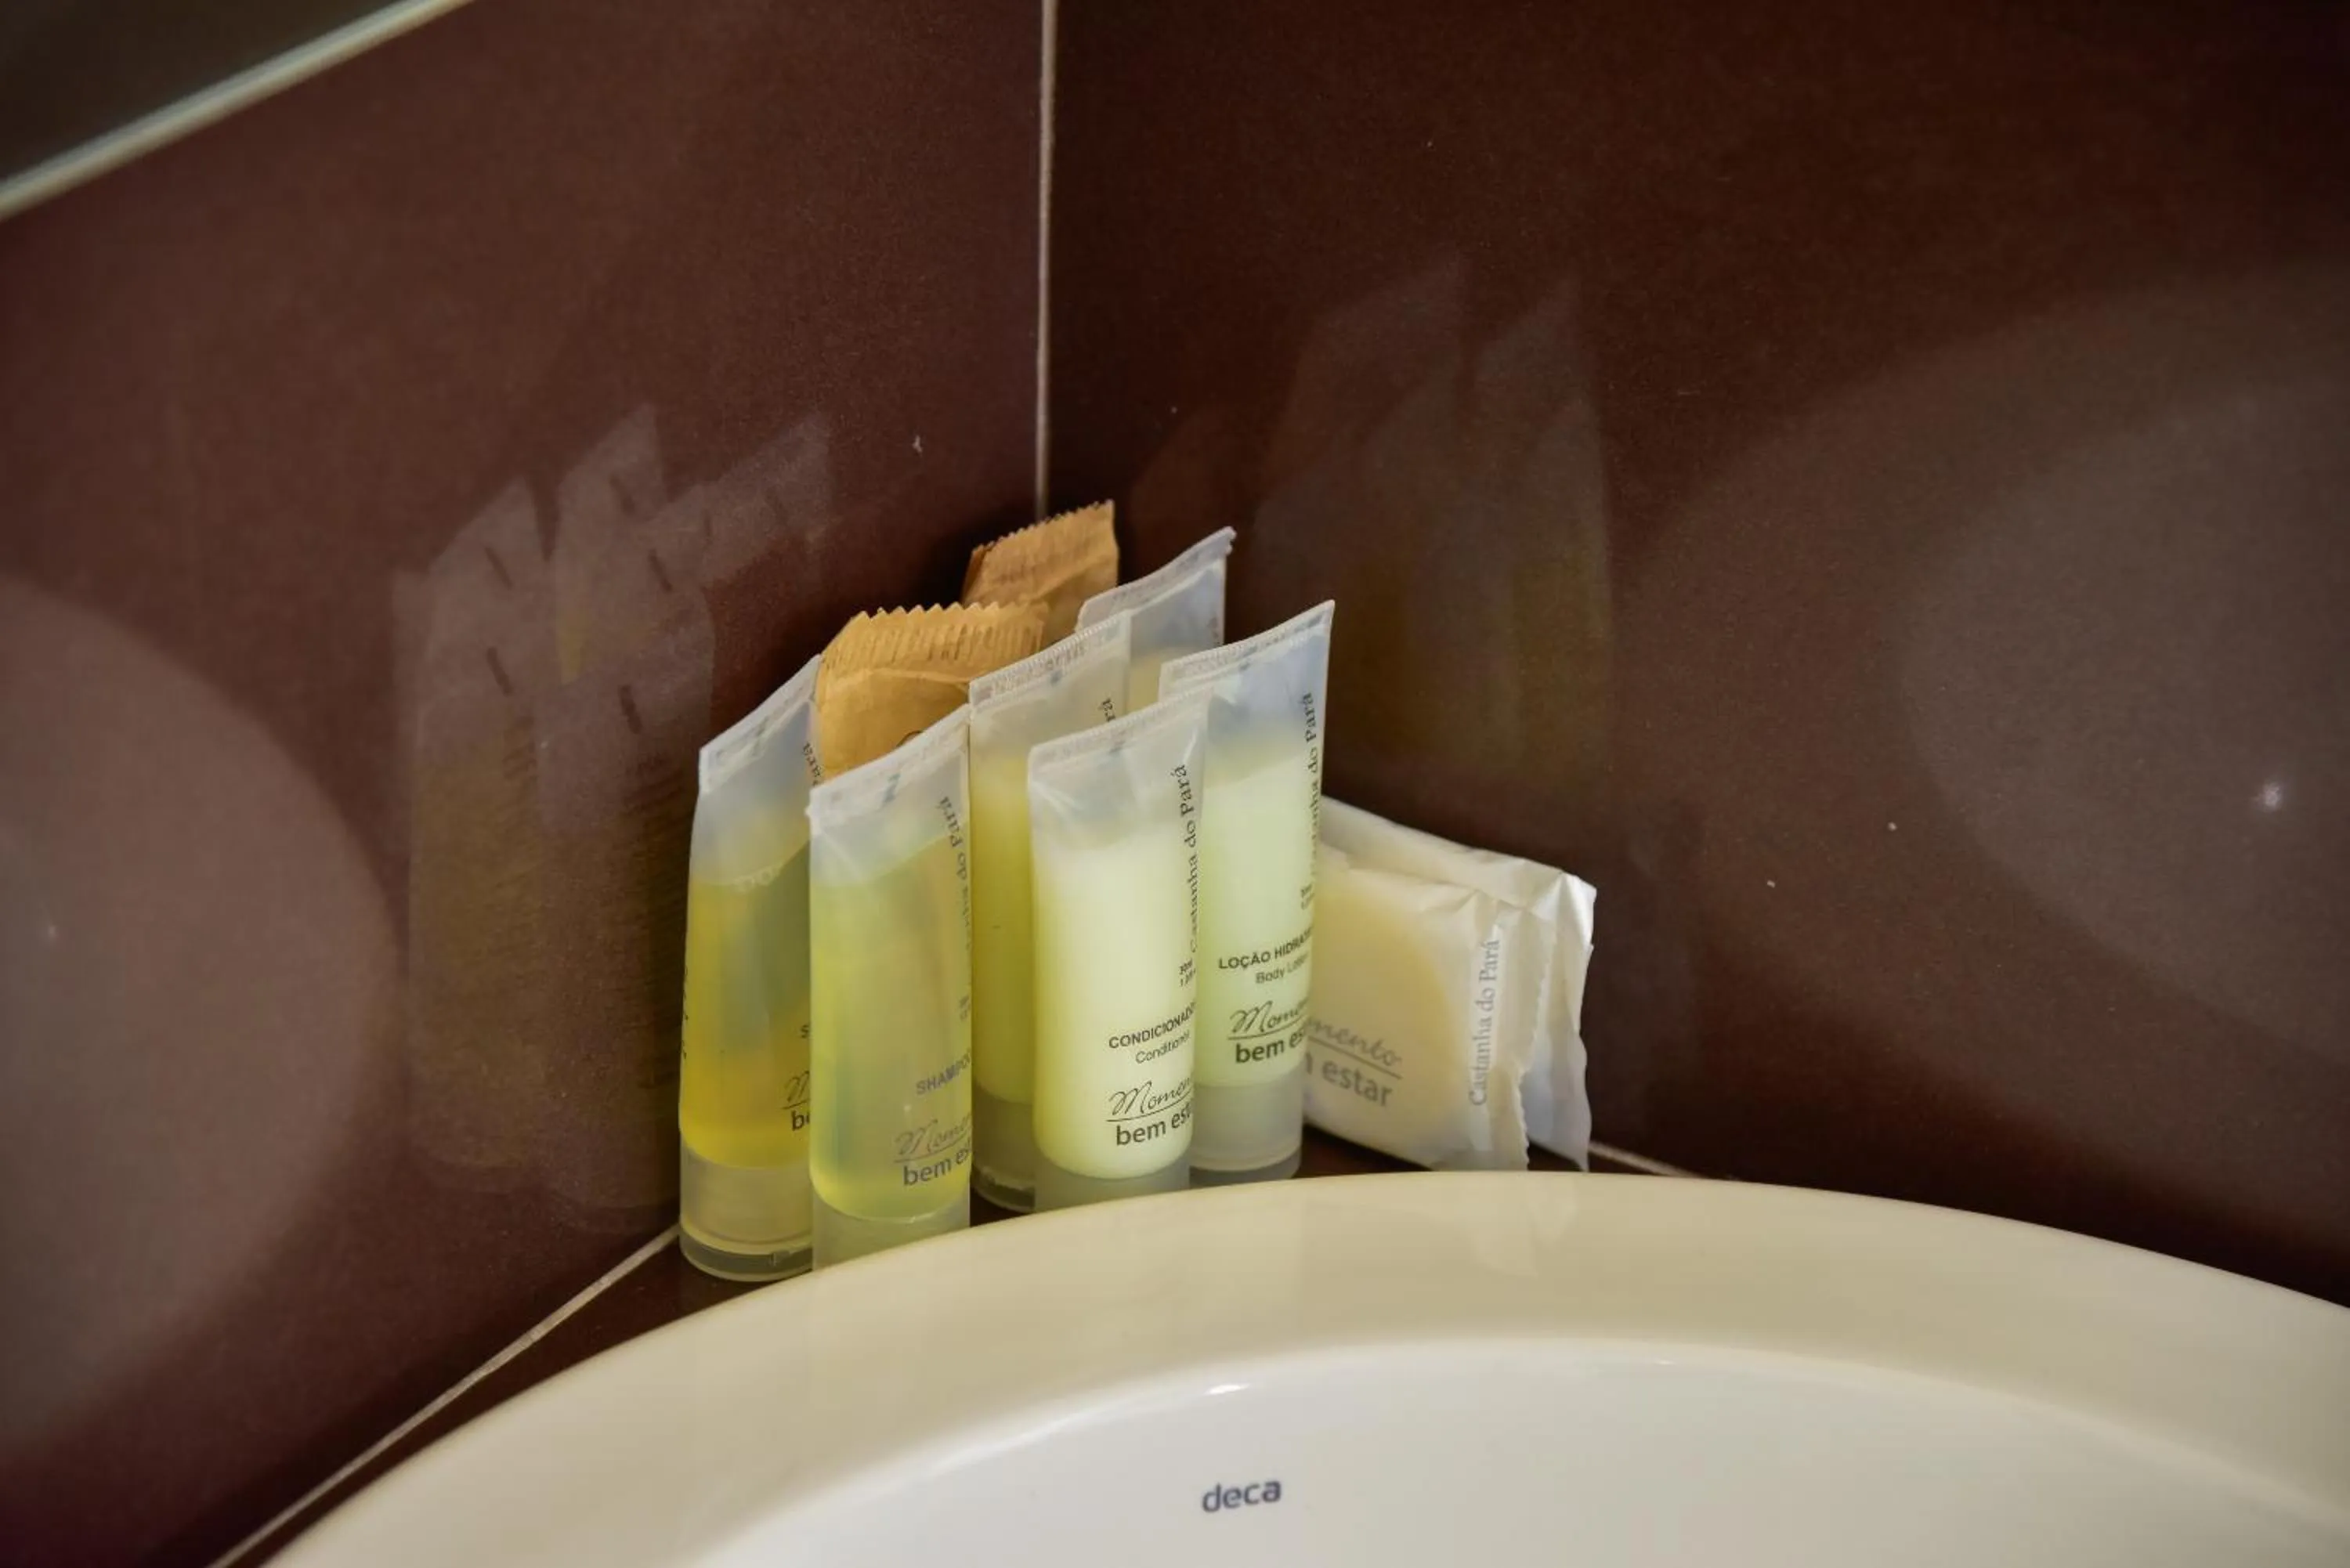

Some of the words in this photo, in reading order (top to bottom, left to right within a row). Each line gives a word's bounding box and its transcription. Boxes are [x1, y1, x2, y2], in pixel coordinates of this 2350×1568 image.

[1171, 764, 1195, 817] Pará
[1184, 819, 1197, 848] do
[1218, 951, 1271, 970] LOÇÃO
[1255, 966, 1285, 984] Body
[1477, 939, 1500, 983] Pará
[1473, 988, 1495, 1013] do
[1235, 1039, 1285, 1064] bem
[1307, 1017, 1404, 1067] mento
[1467, 1017, 1492, 1106] Castanha
[1108, 1077, 1191, 1116] Momen
[1321, 1060, 1394, 1107] estar
[1116, 1121, 1166, 1147] bem
[902, 1157, 953, 1187] bem
[1202, 1479, 1282, 1513] deca
